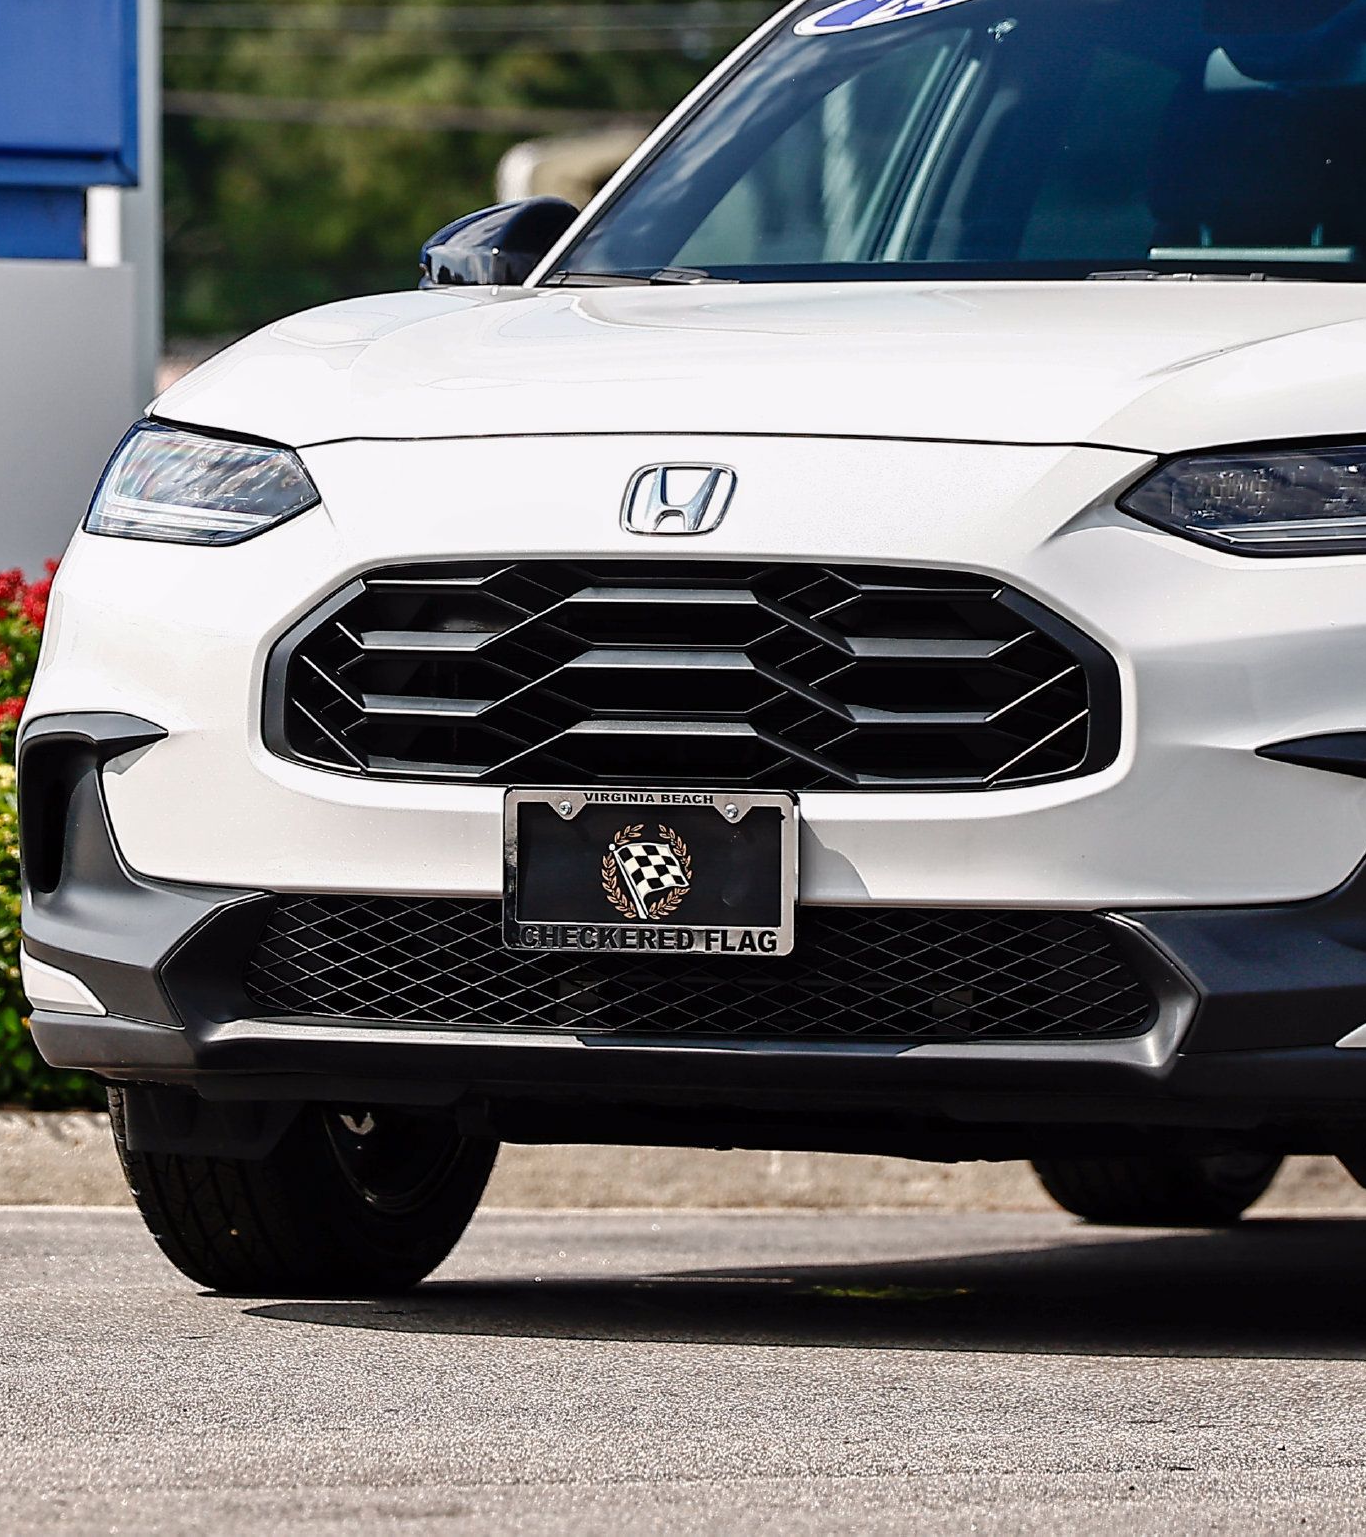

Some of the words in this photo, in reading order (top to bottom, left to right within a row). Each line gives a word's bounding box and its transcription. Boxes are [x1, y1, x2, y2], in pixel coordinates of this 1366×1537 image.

[583, 792, 655, 804] VIRGINIA
[660, 793, 714, 805] BEACH
[520, 925, 694, 951] CHECKERED
[704, 929, 777, 953] FLAG
